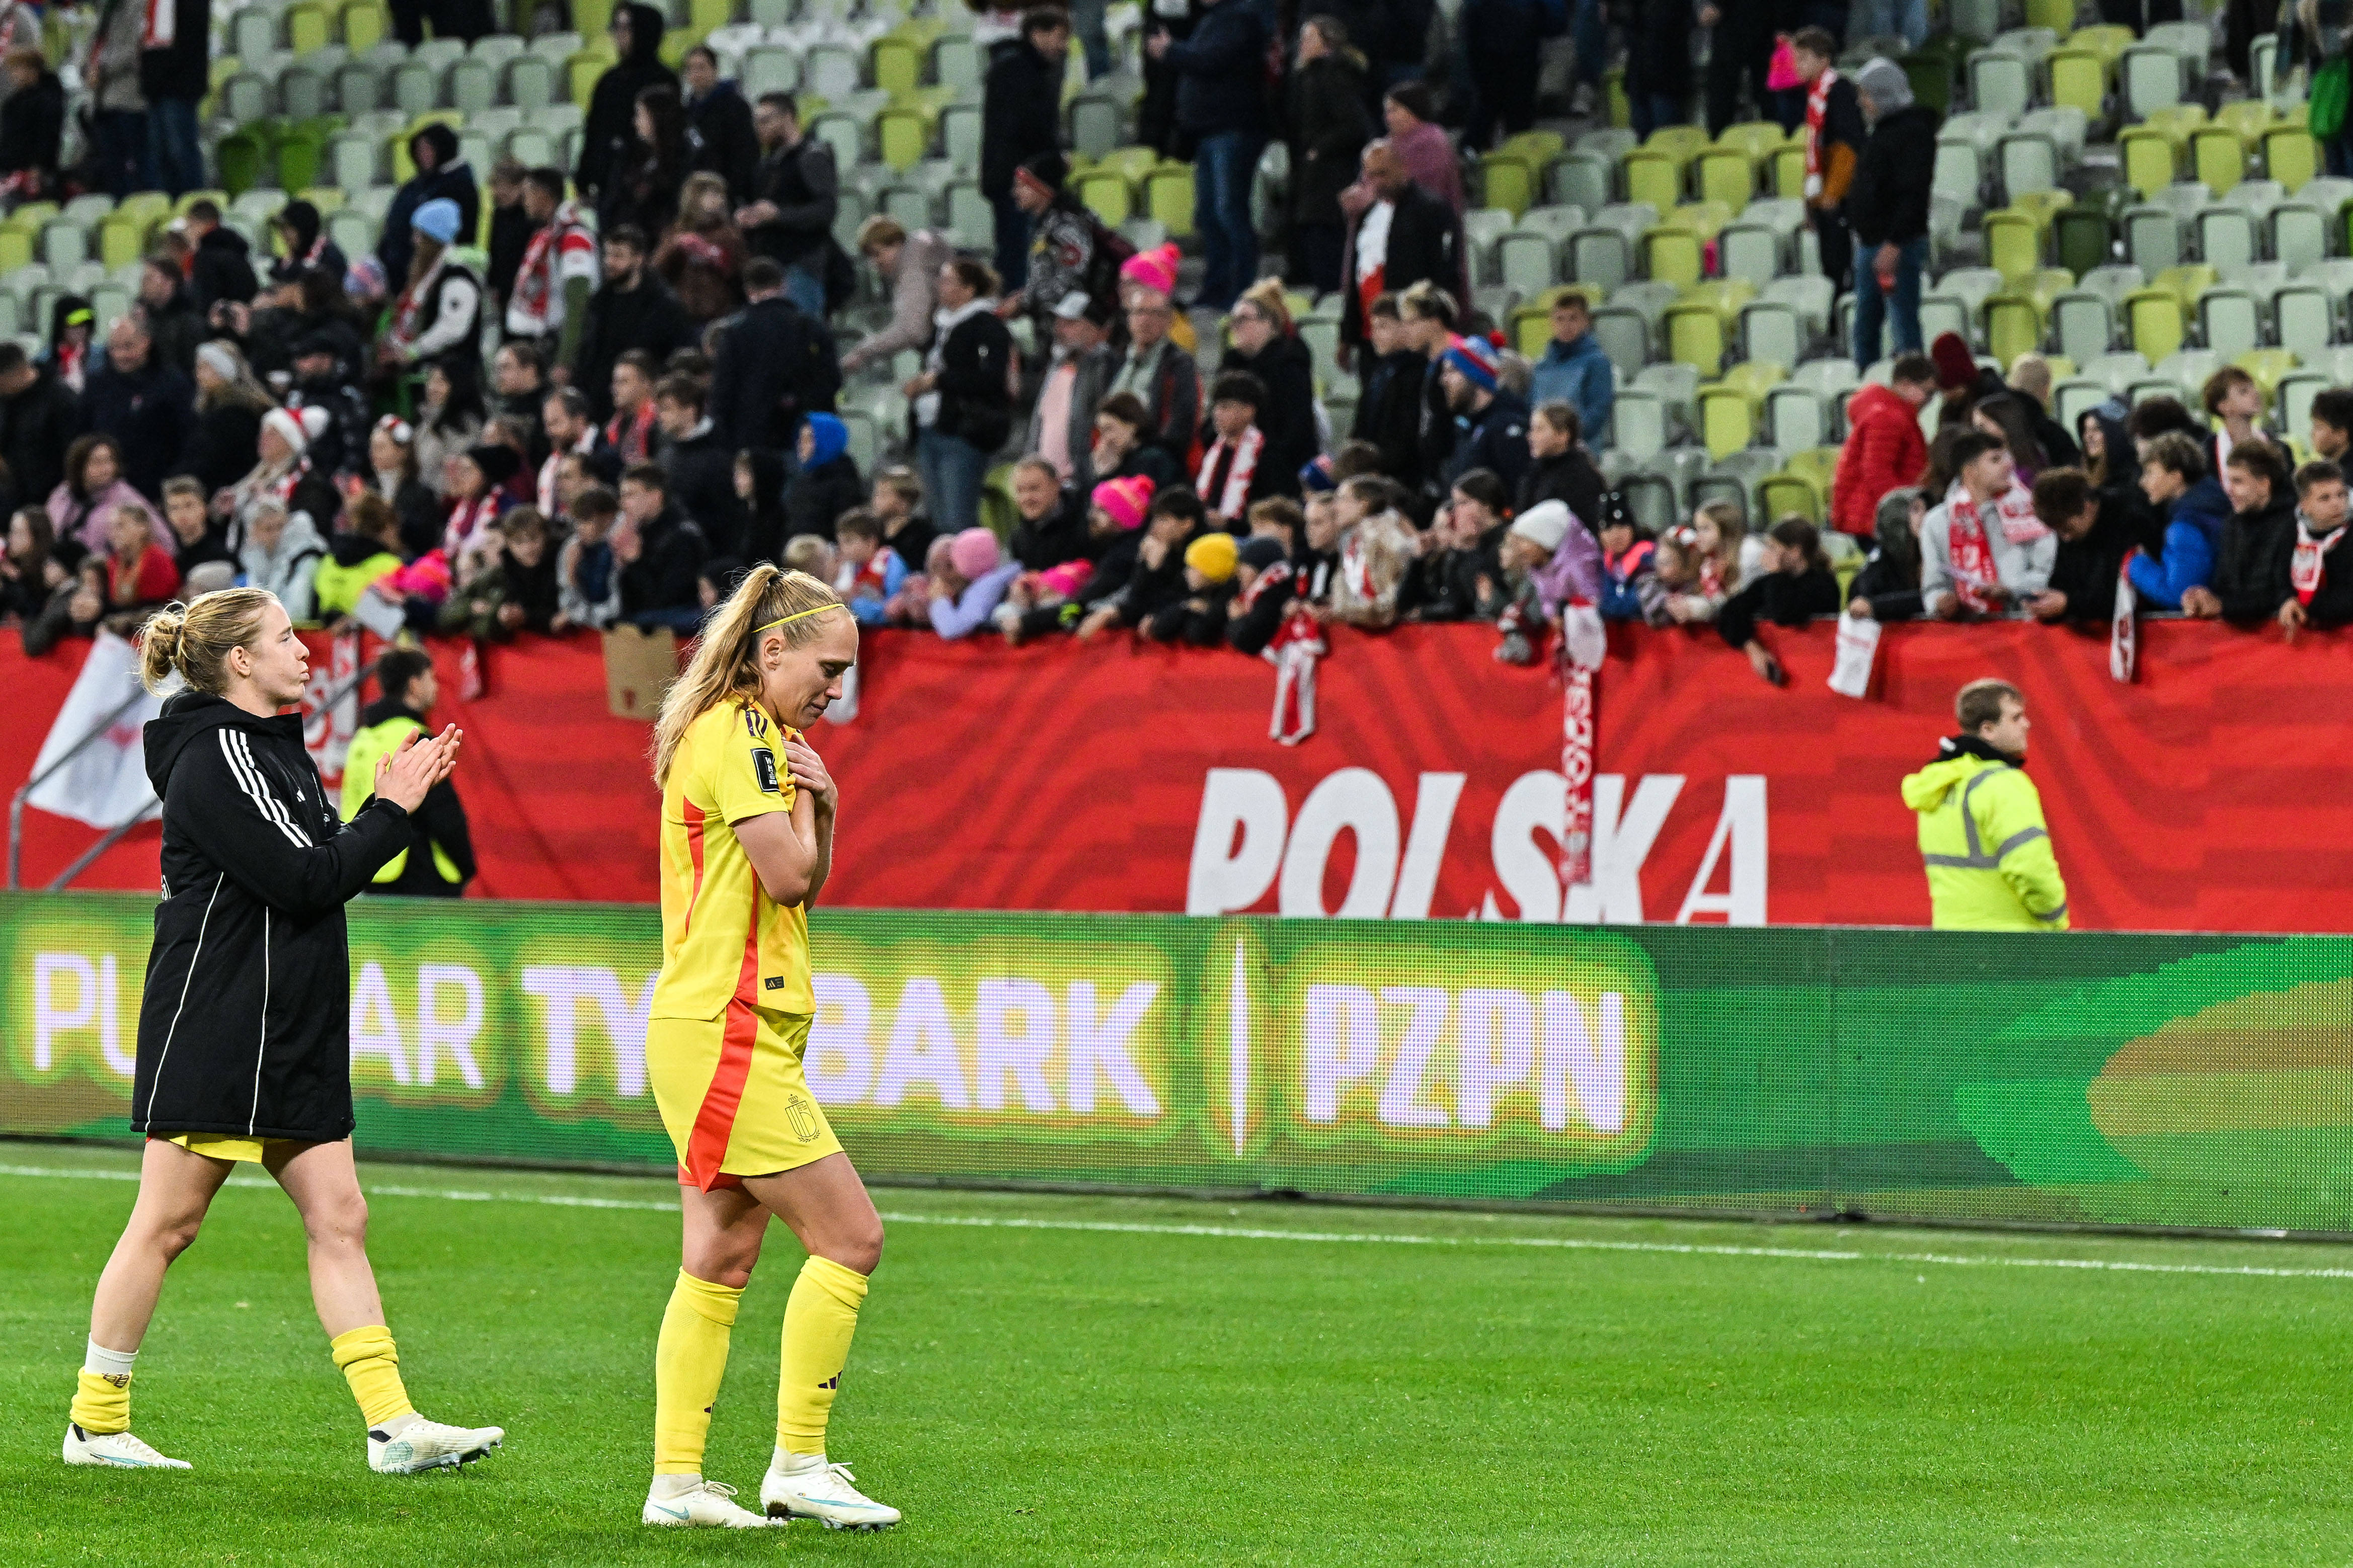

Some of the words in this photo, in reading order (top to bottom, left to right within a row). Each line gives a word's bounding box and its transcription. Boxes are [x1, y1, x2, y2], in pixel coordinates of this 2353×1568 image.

[1186, 766, 1767, 925] POLSKA
[35, 952, 485, 1089] PUAR
[520, 965, 1162, 1117] TYBARK
[1305, 982, 1625, 1134] PZPN
